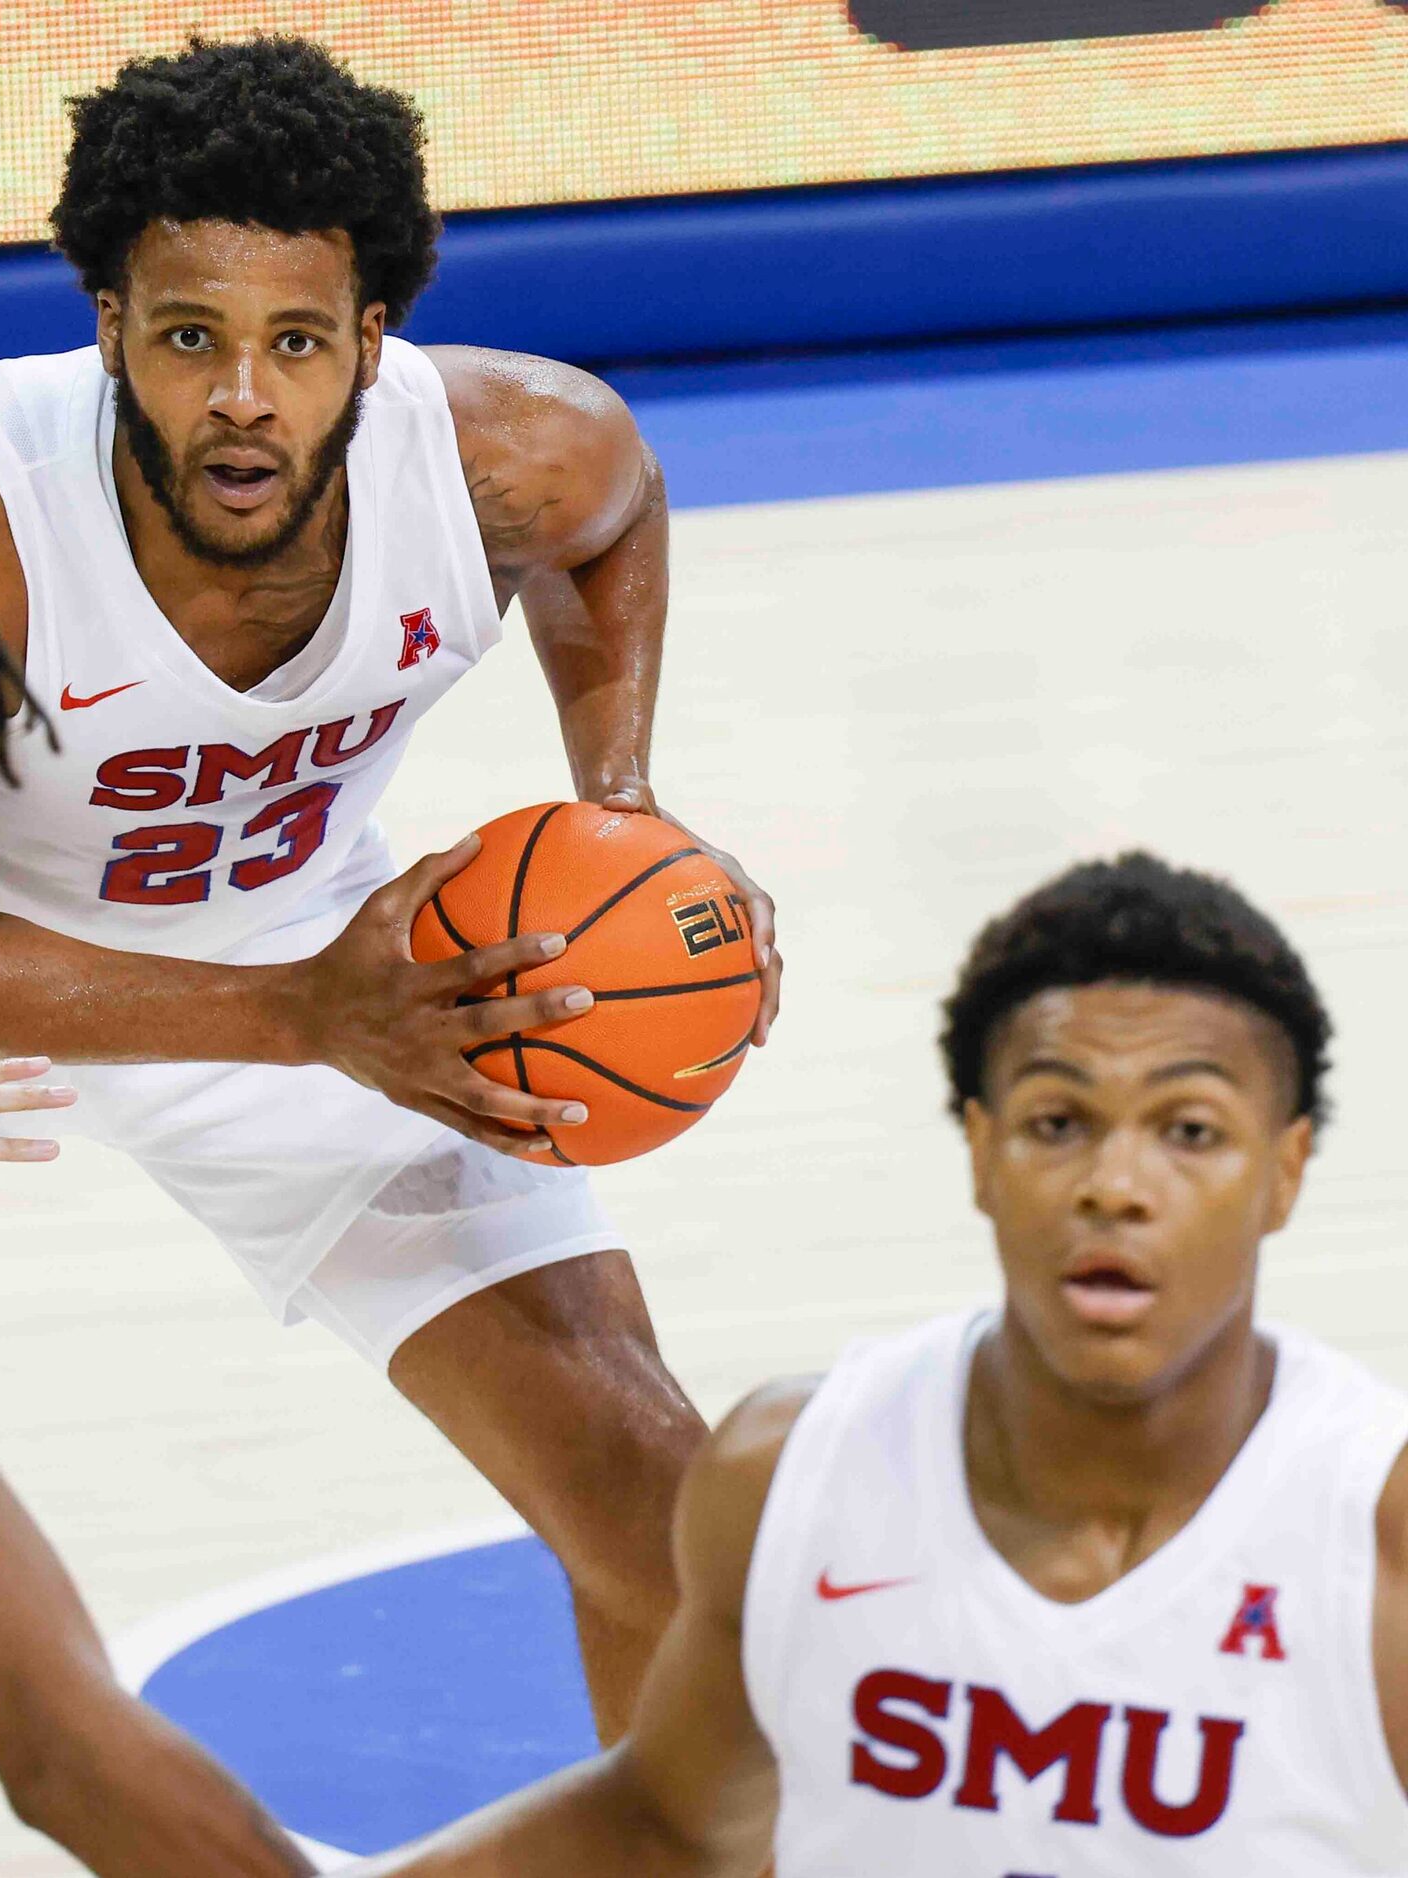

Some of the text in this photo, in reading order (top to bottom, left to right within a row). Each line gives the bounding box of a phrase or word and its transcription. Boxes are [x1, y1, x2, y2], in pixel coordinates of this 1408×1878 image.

[397, 607, 442, 671] A
[89, 697, 408, 812] SMU
[98, 780, 344, 906] 23
[1218, 1582, 1289, 1662] A
[849, 1667, 1246, 1839] SMU
